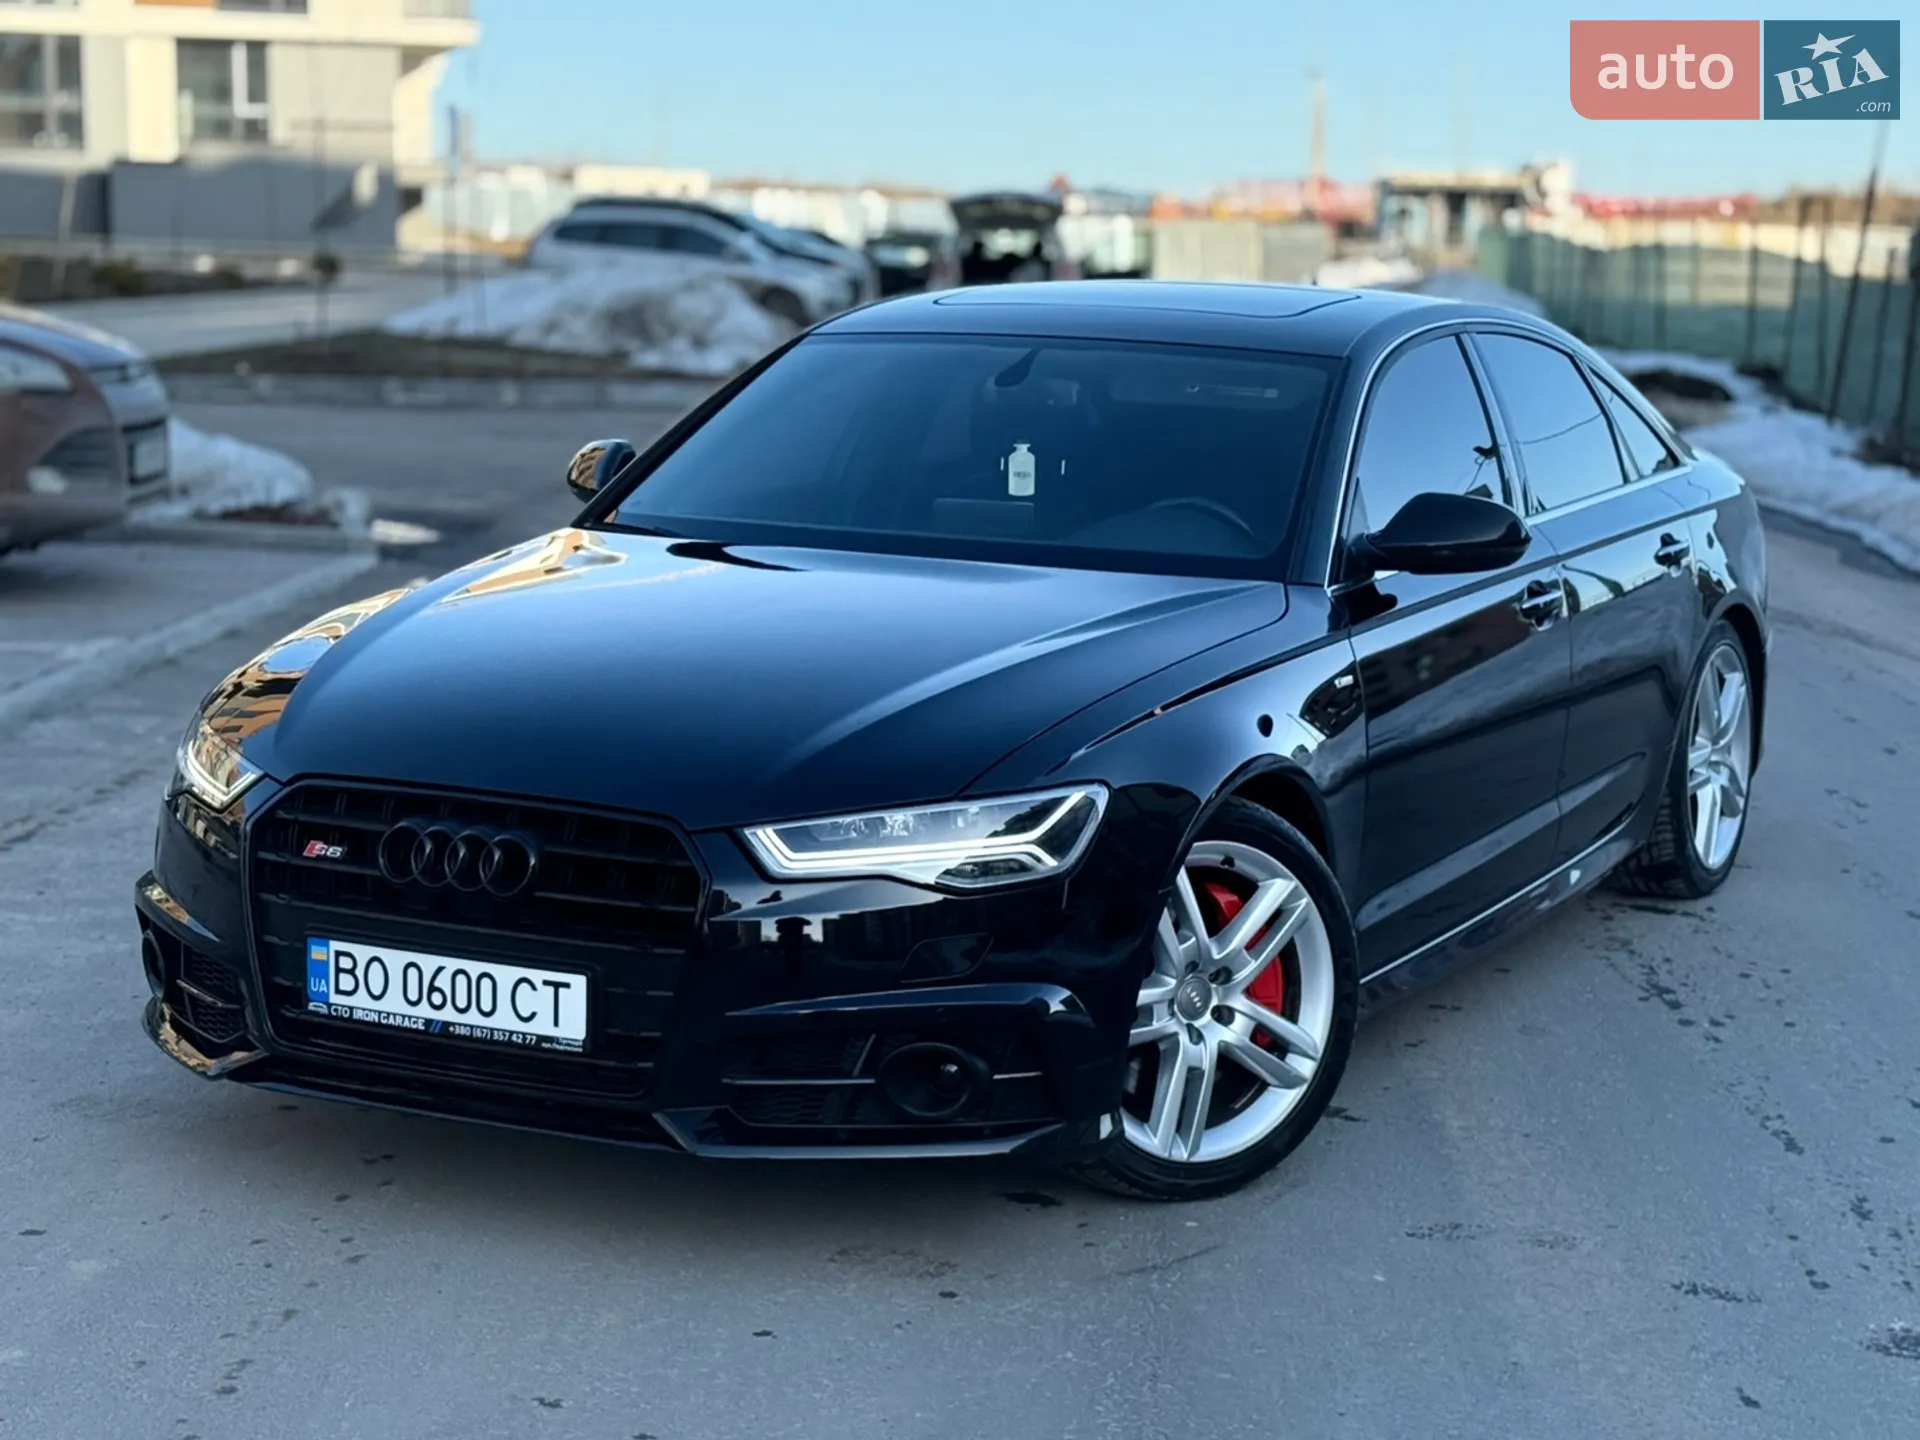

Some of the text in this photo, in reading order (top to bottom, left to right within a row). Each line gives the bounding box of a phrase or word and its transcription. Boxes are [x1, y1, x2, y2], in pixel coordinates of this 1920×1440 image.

[312, 842, 343, 858] S6
[310, 976, 328, 994] UA
[334, 949, 571, 1028] BO 0600 CT
[352, 1008, 379, 1023] IRON
[380, 1013, 426, 1031] GARAGE
[448, 1024, 537, 1046] +380 (67) 357 42 77
